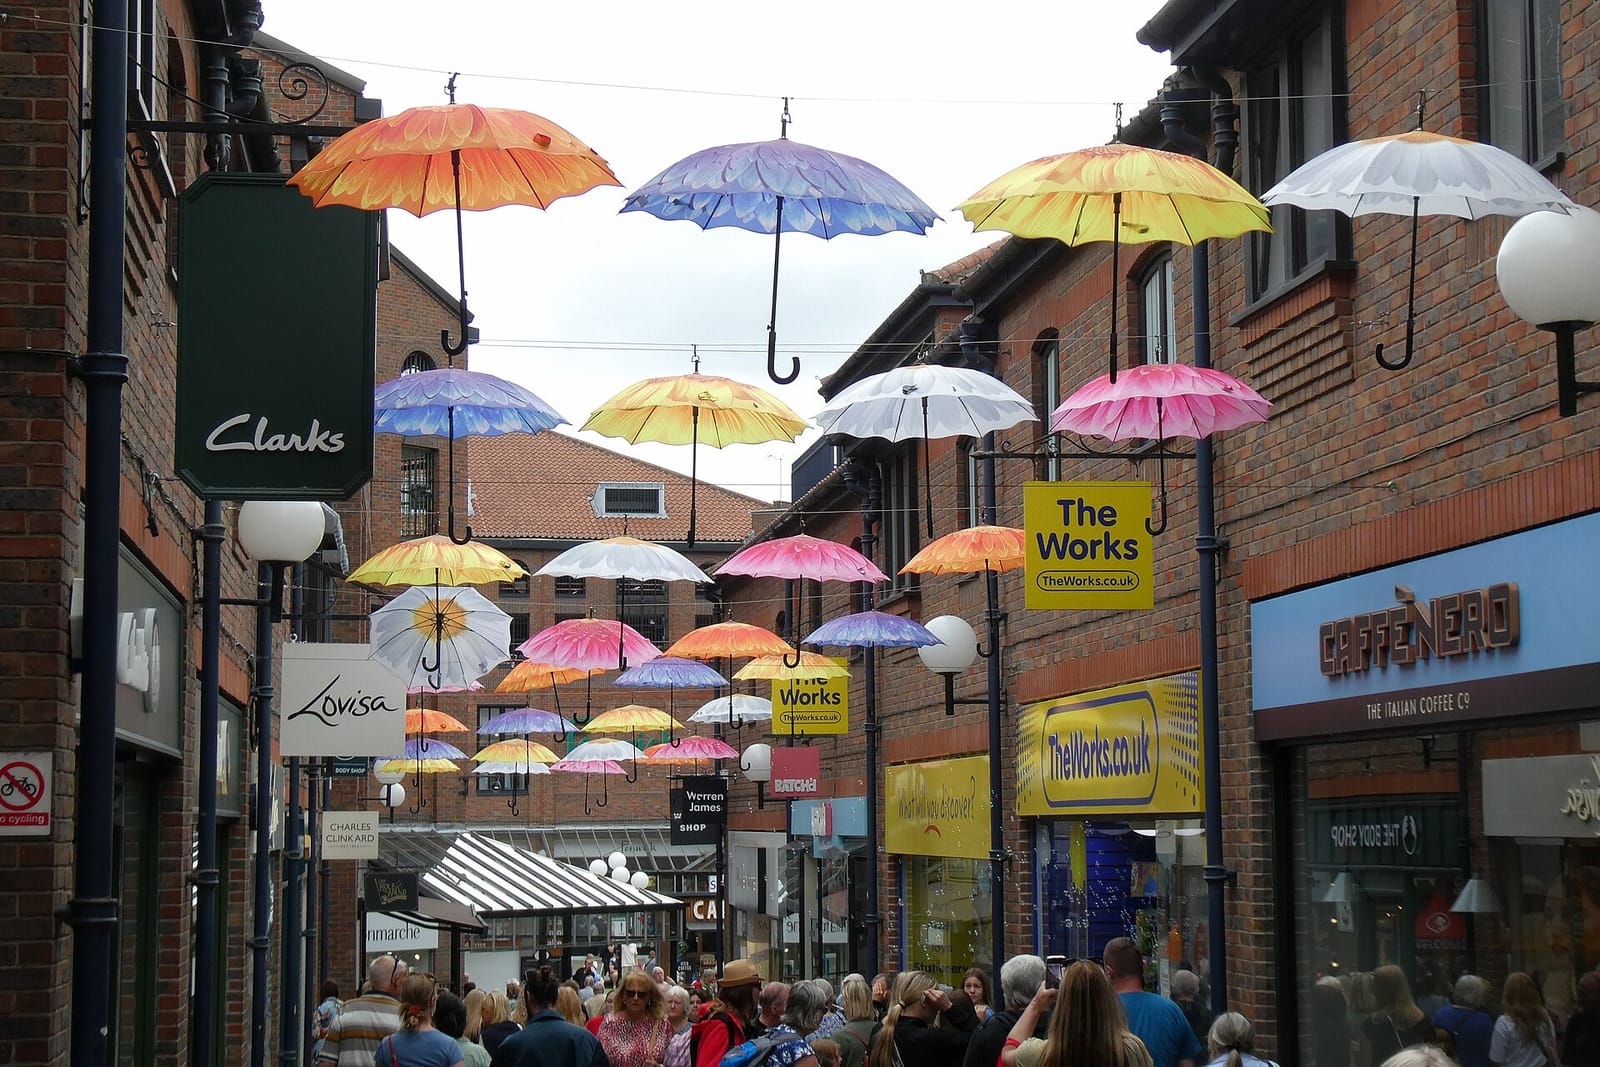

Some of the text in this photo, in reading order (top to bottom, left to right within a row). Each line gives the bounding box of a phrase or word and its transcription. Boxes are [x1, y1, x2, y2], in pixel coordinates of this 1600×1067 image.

[205, 413, 345, 453] Clarks
[1056, 497, 1118, 527] The
[1036, 531, 1139, 560] Works
[1042, 575, 1135, 587] TheWorks.co.uk
[287, 674, 400, 727] Lovisa
[779, 688, 842, 706] Works
[1367, 704, 1382, 720] THE
[1385, 699, 1417, 717] ITALIAN
[1419, 694, 1454, 714] COFFEE
[783, 714, 839, 722] TheWorks.co.uk
[1048, 718, 1152, 781] TheWorks.co.uk
[351, 766, 366, 774] SHOP
[686, 790, 724, 801] Warren
[926, 799, 939, 825] you
[940, 775, 976, 822] discover?
[689, 802, 721, 812] James
[8, 813, 45, 824] cycling
[329, 823, 371, 832] CHARLES
[679, 823, 707, 832] SHOP
[325, 834, 375, 843] CLINKARD
